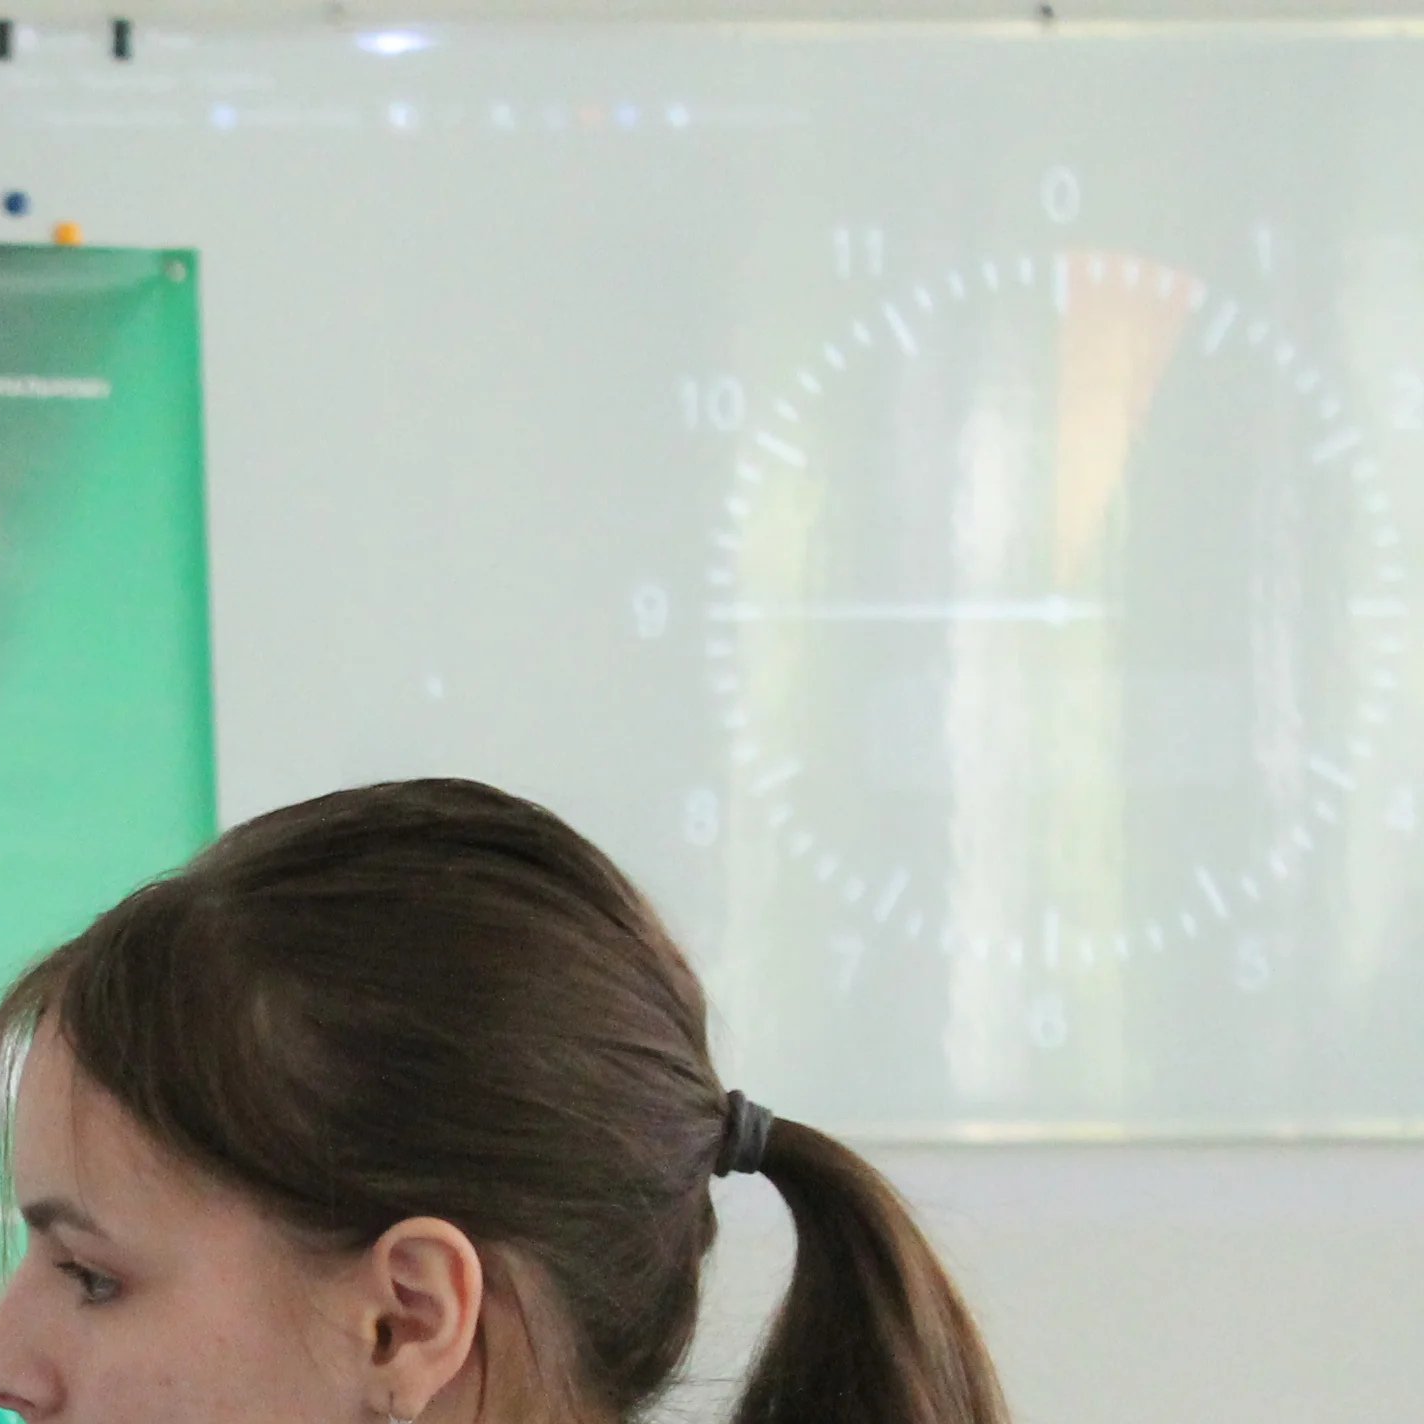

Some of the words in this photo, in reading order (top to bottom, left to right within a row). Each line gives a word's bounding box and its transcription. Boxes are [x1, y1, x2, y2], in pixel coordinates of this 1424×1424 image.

[1041, 166, 1080, 223] 0
[834, 227, 884, 279] 11
[681, 376, 746, 433] 10
[634, 582, 669, 640] 9
[682, 787, 720, 847] 8
